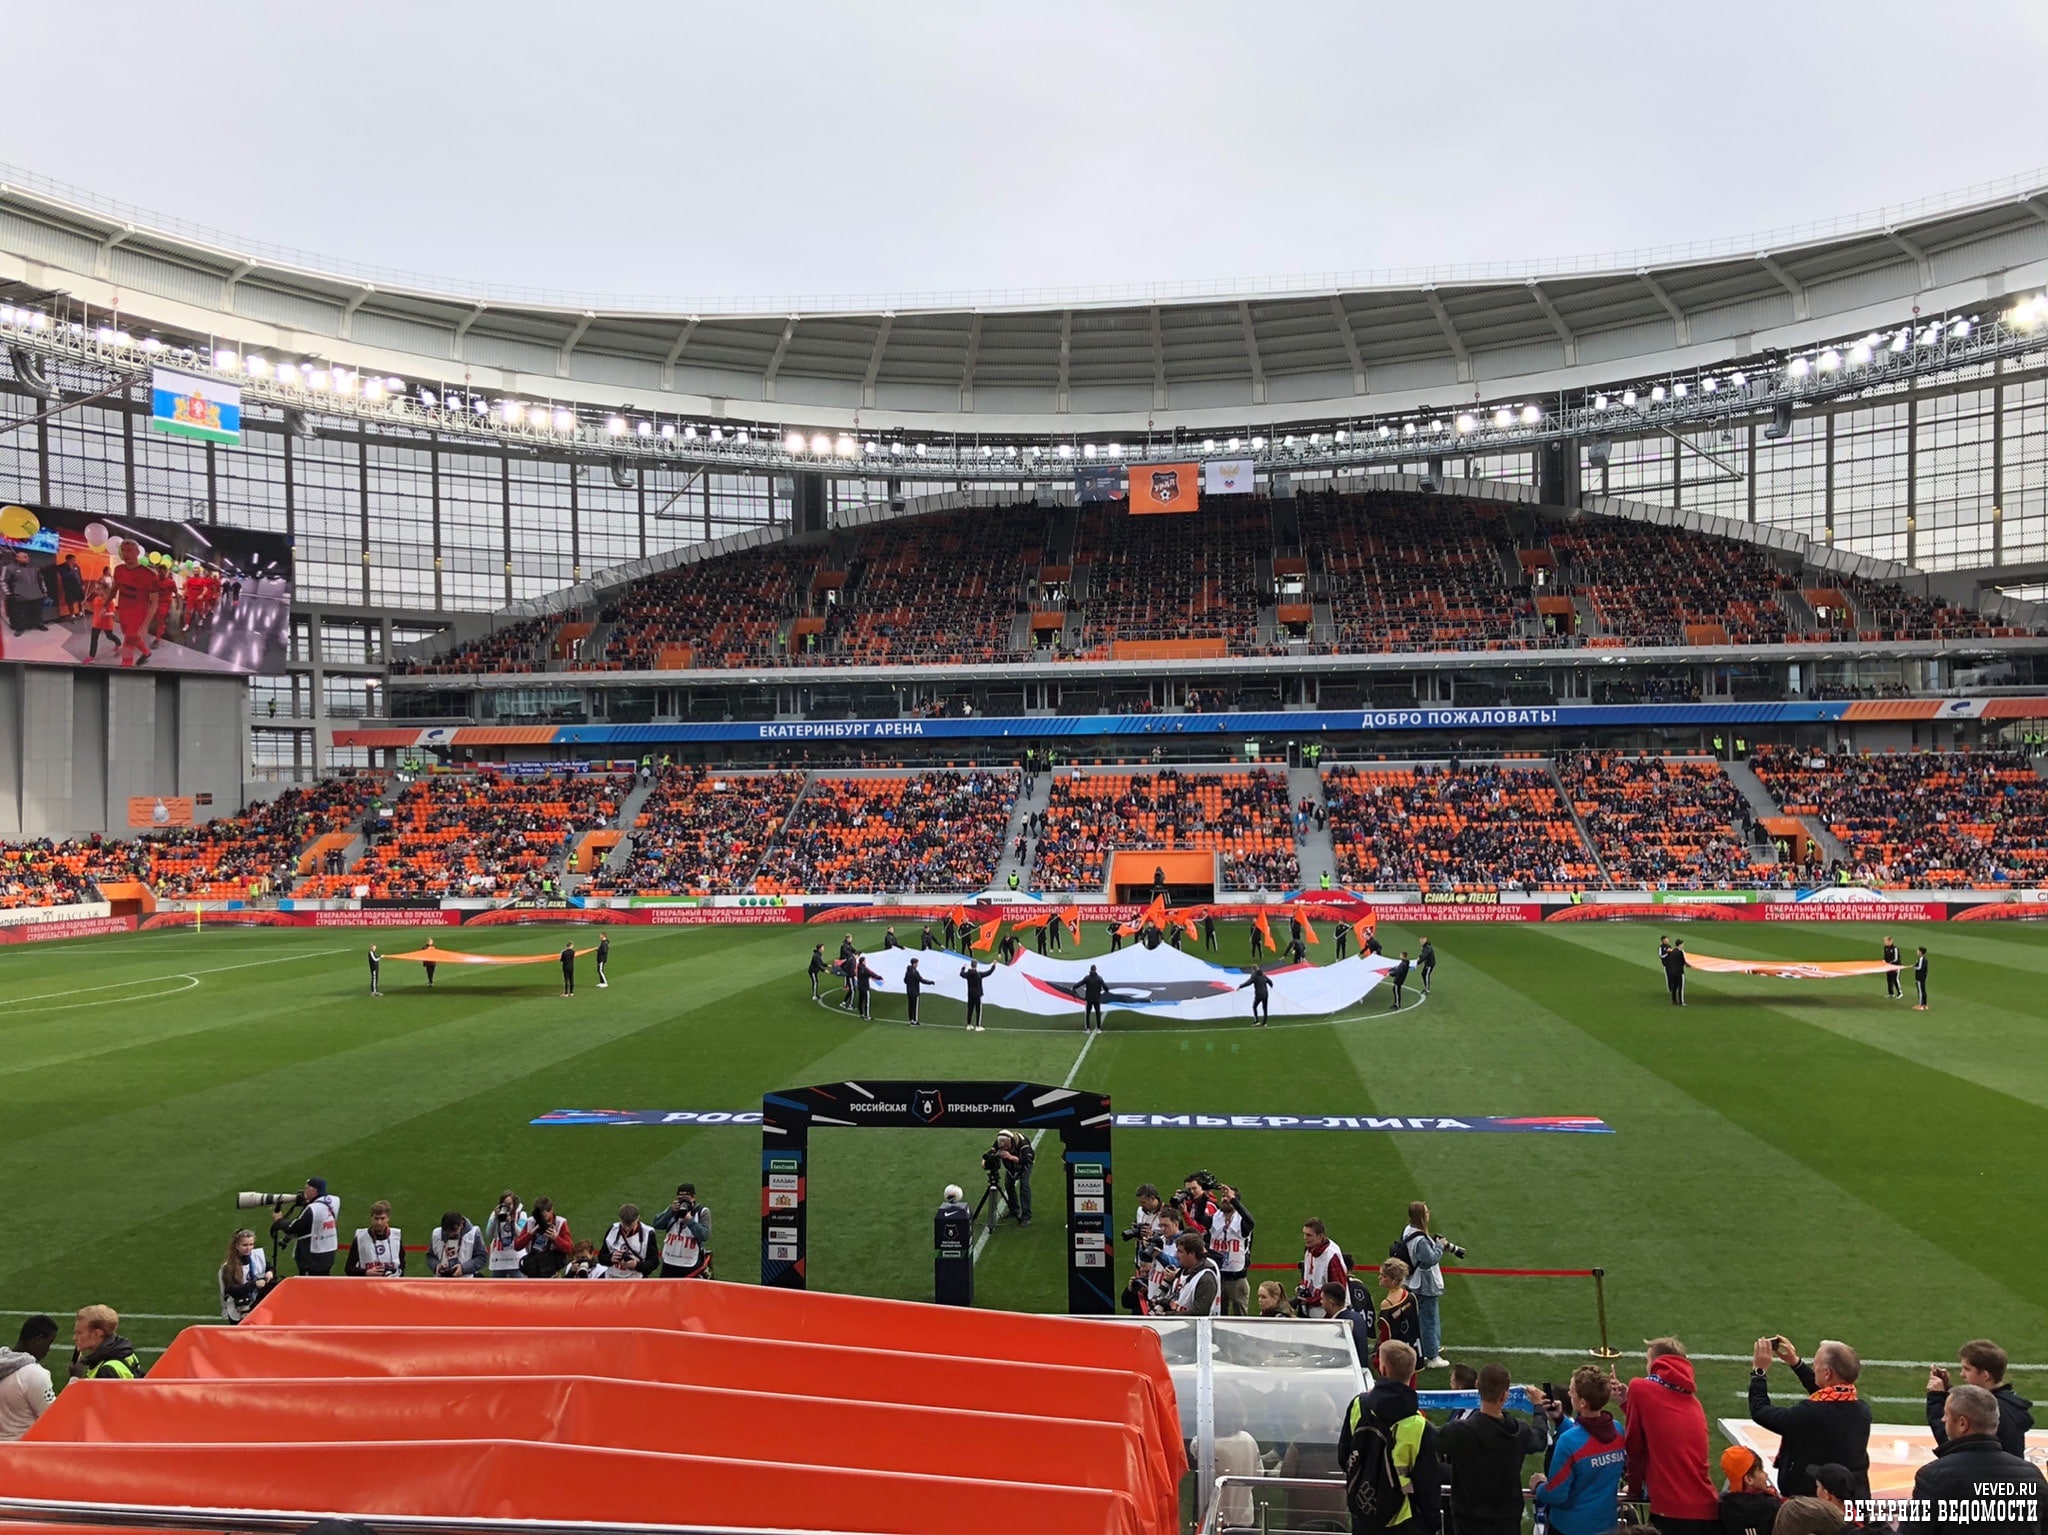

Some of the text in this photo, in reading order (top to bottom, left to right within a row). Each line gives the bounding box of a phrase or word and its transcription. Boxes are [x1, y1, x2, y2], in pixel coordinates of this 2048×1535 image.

[1362, 710, 1556, 728] ДОБРО ПОЖАЛОВАТЬ!
[760, 723, 923, 737] ЕКАТЕРИНБУРГ АРЕНА
[652, 909, 702, 917] ГЕНЕРАЛЬНЫЙ
[702, 909, 743, 918] ПОДРЯДЧИК
[1371, 905, 1425, 913] ГЕНЕРАЛЬНЫЙ
[1427, 906, 1474, 914] ПОДРЯДЧИК
[1765, 904, 1822, 912] ГЕНЕРАЛЬНЫЙ
[1825, 904, 1874, 913] ПОДРЯДЧИК
[316, 910, 362, 919] ГЕНЕРАЛЬНЫЙ
[364, 911, 403, 920] ПОДРЯДЧИК
[27, 921, 66, 933] ГЕНЕРАЛЬНЫЙ
[66, 920, 98, 930] ПОДРЯДЧИК
[27, 929, 70, 941] СТРОИТЕЛЬСТВА
[850, 1102, 1015, 1113] РОССИЙСКАЯ ПРЕМЬЕР-ЛИГА
[1112, 1114, 1474, 1129] ЕМЬЕР-ЛИГА
[1591, 1451, 1625, 1468] RUSSIA
